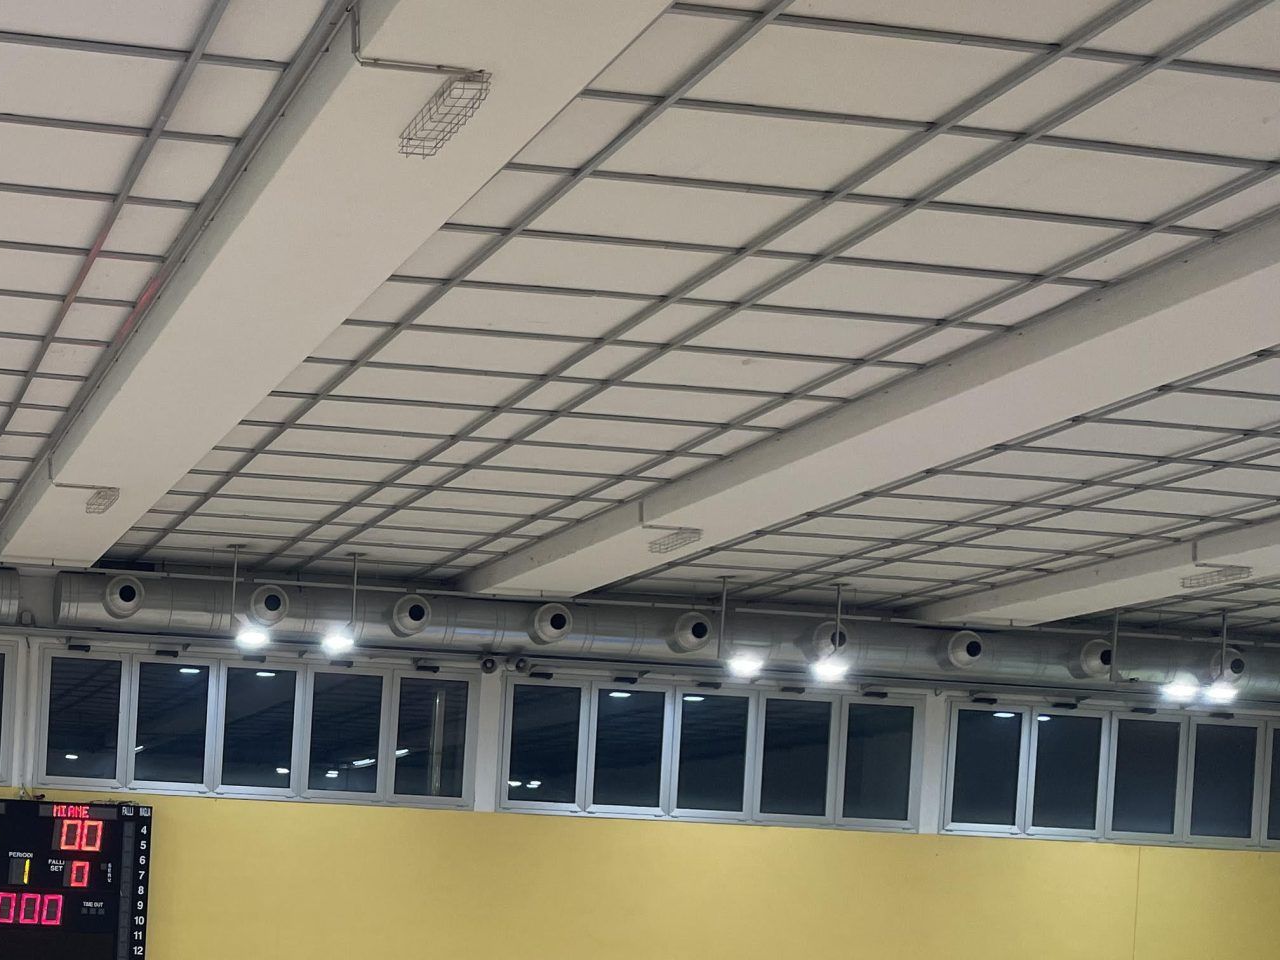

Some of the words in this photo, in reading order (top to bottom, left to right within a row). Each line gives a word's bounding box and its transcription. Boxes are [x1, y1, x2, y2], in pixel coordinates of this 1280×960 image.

[53, 805, 89, 818] MIANE
[141, 826, 147, 834] 4
[60, 820, 103, 851] 00
[140, 841, 146, 850] 5
[139, 856, 146, 865] 6
[23, 859, 30, 884] 1
[70, 861, 90, 887] 0
[139, 871, 145, 880] 7
[138, 886, 144, 895] 8
[137, 901, 143, 910] 9
[135, 916, 145, 925] 10
[134, 931, 143, 940] 11
[133, 946, 143, 955] 12
